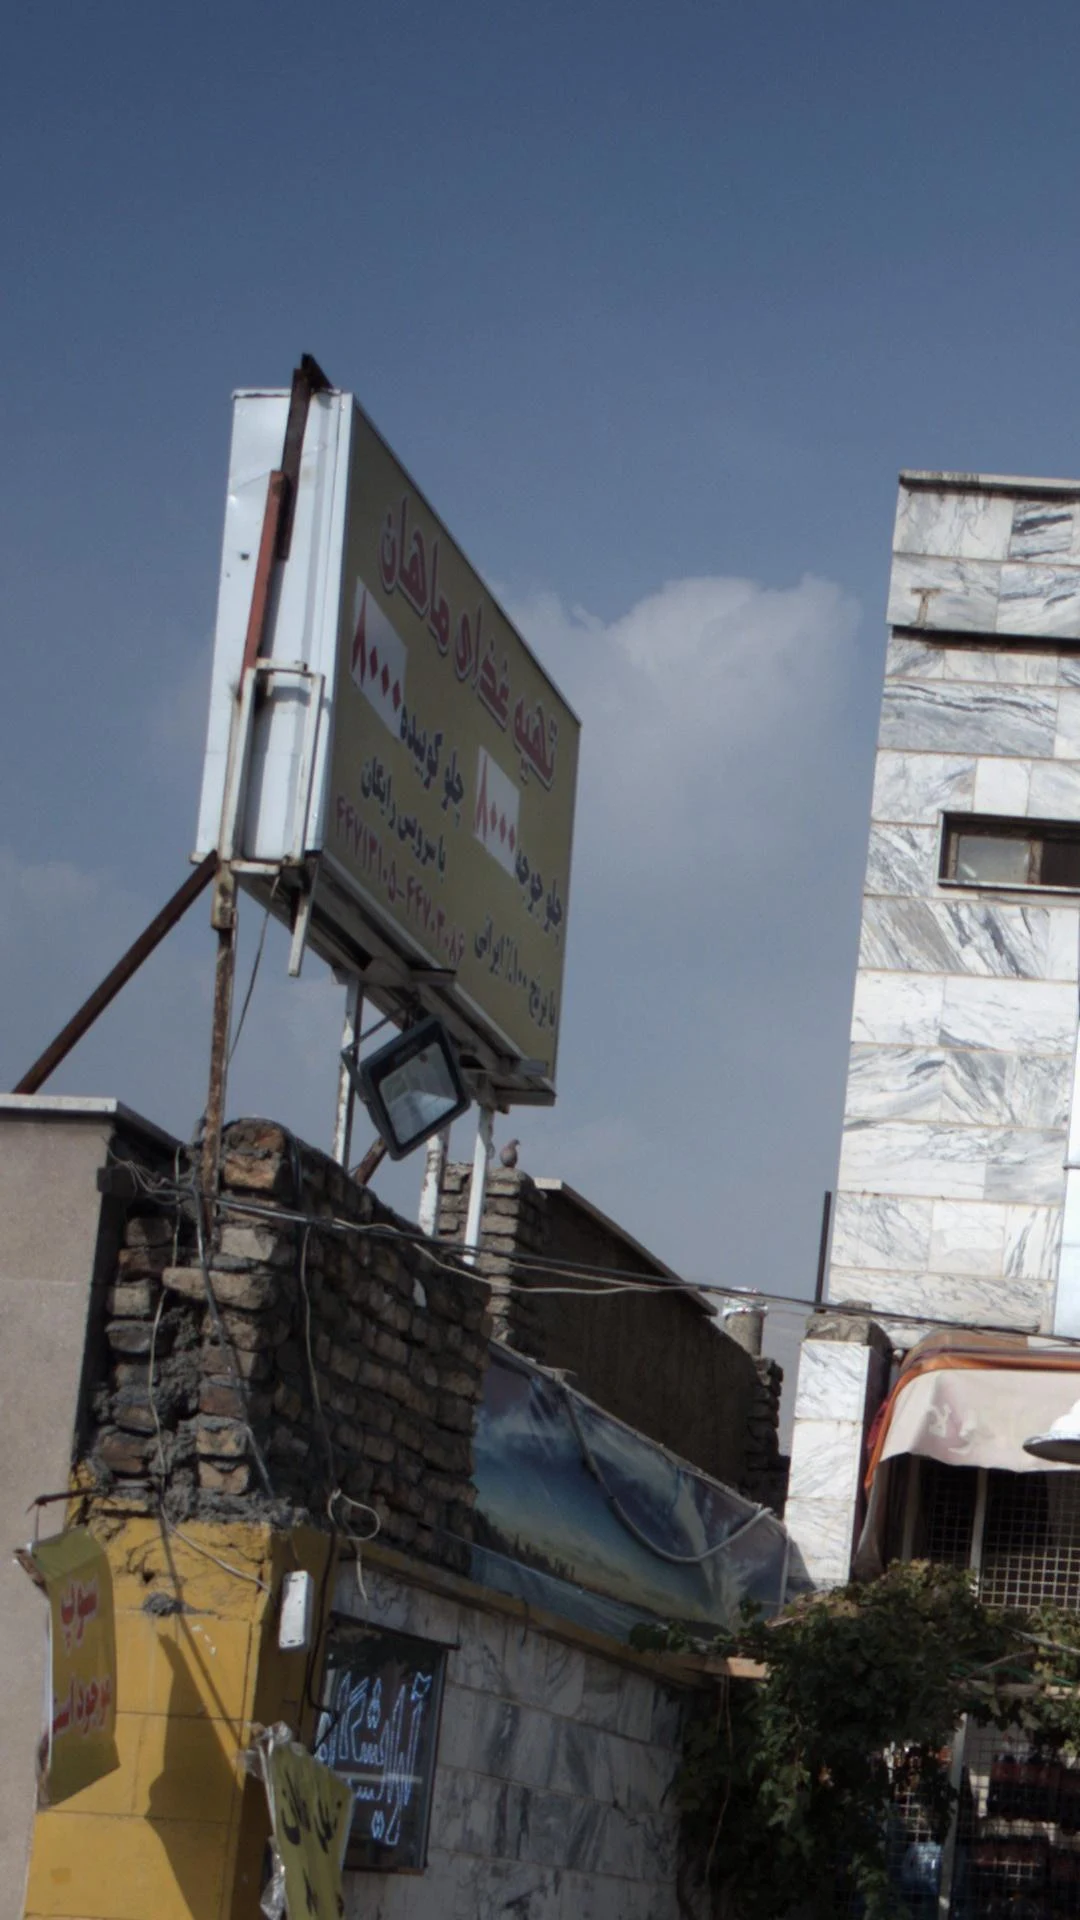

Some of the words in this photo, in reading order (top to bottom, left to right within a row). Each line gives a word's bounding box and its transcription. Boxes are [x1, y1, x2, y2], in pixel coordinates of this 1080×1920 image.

[379, 496, 450, 657] ماهان
[352, 590, 400, 712] ۸۰۰۰
[455, 602, 510, 731] غذای
[513, 695, 557, 791] تهیه
[361, 756, 396, 830] رایگان
[441, 751, 464, 828] چلو
[475, 753, 516, 853] ۸۰۰۰
[398, 815, 435, 867] سرویس
[437, 833, 446, 883] با
[515, 849, 543, 918] جوجه
[543, 878, 562, 946] چلو
[529, 974, 548, 1028] برنج
[61, 1581, 98, 1649] سوپ
